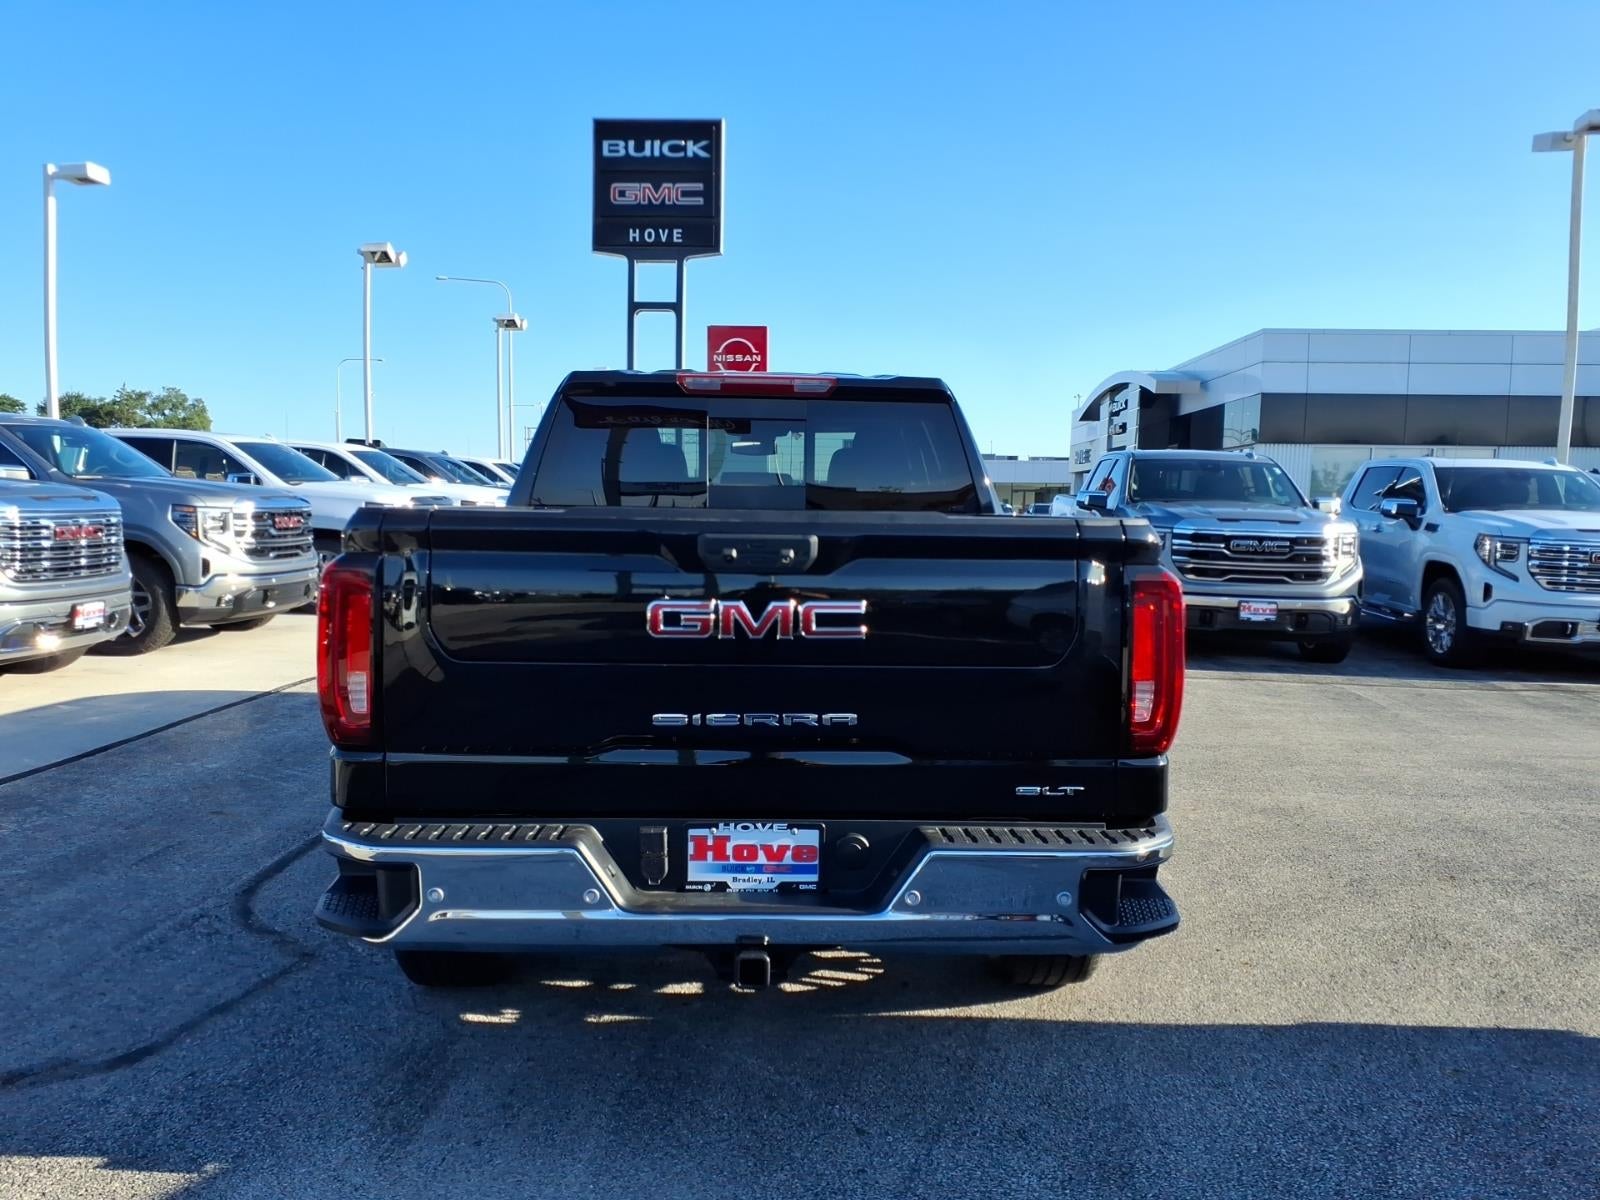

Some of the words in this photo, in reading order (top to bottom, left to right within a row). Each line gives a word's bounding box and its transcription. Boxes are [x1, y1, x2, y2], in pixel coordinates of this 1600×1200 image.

[602, 139, 711, 158] BUICK
[610, 182, 705, 205] GMC
[628, 228, 684, 243] HOVE
[713, 353, 761, 363] NISSAN
[1230, 540, 1290, 553] GMC
[646, 599, 868, 640] GMC
[652, 713, 858, 726] SIERRA
[1015, 786, 1085, 796] SLT
[718, 822, 789, 833] HOVE
[689, 835, 818, 862] Hove
[732, 876, 764, 885] Bradley,
